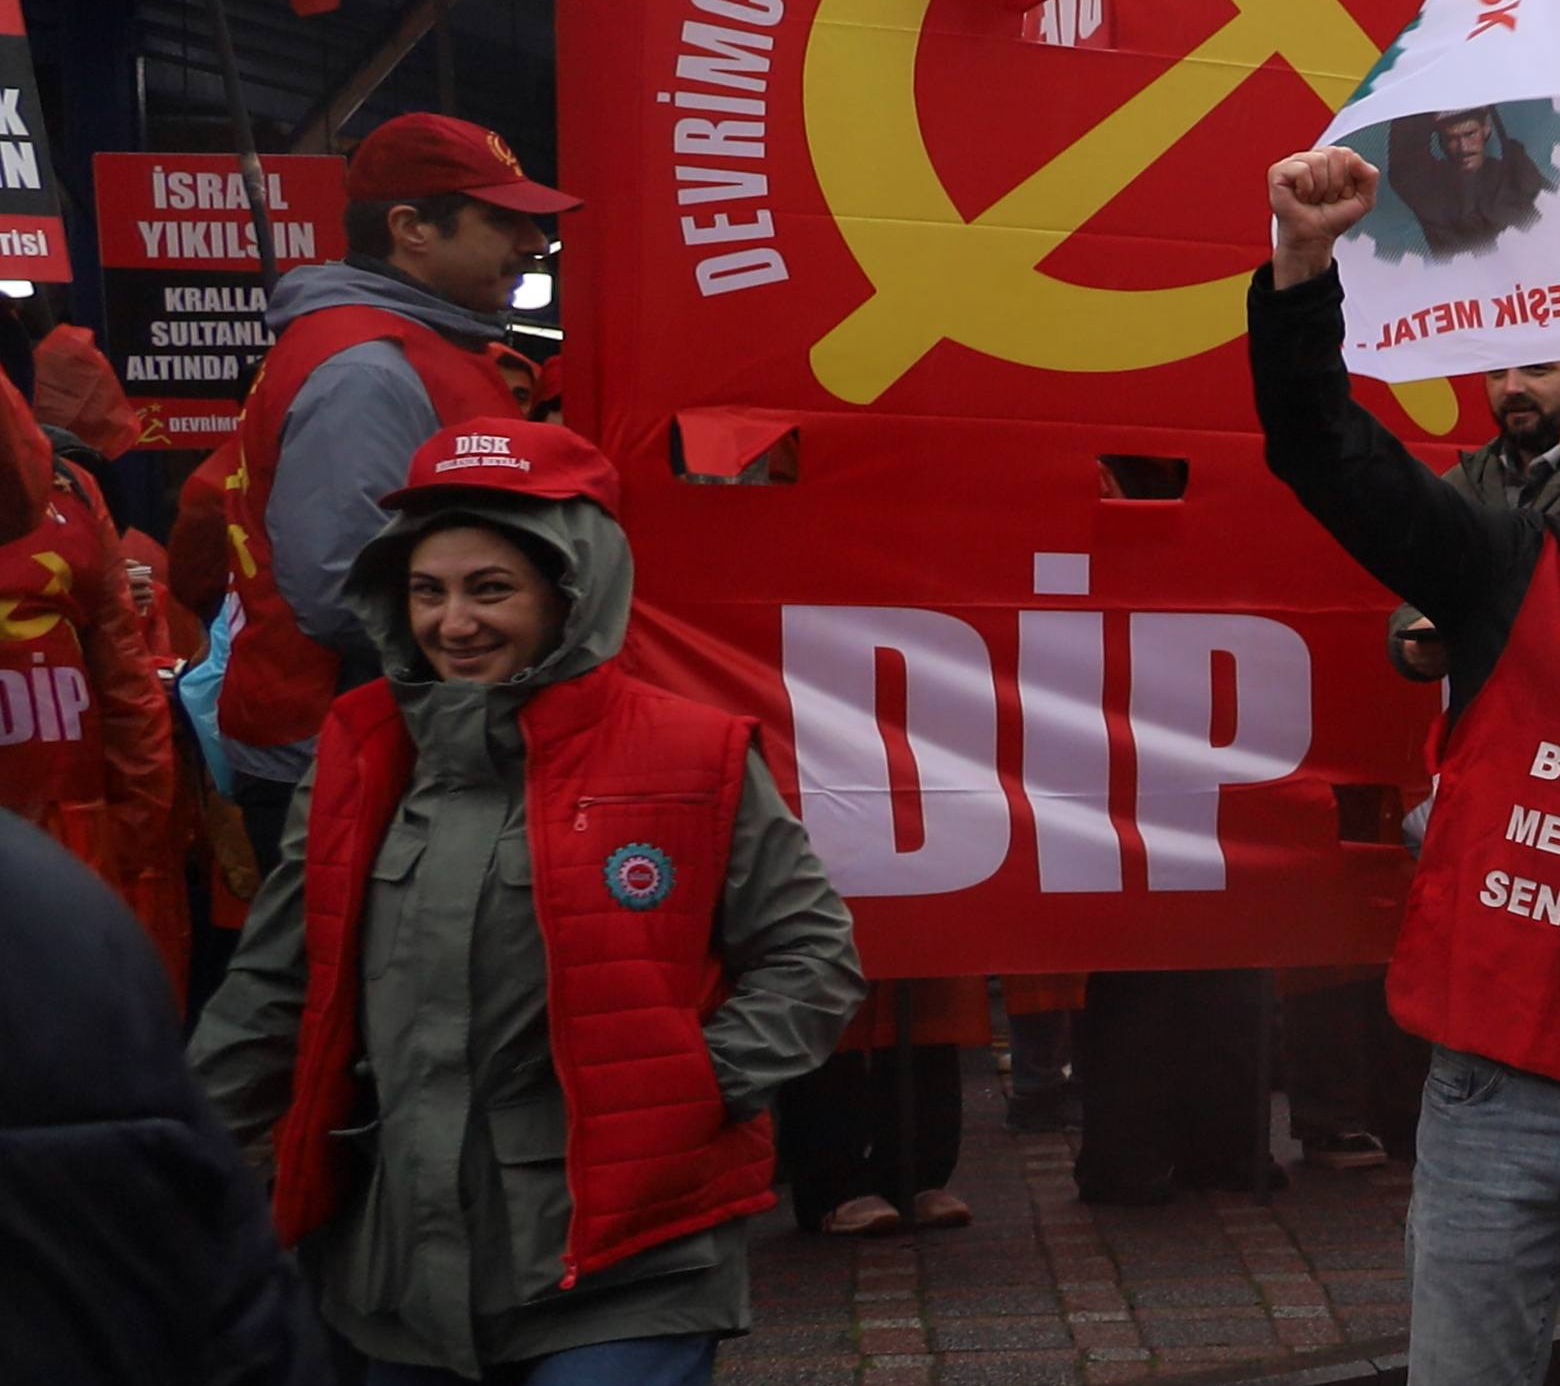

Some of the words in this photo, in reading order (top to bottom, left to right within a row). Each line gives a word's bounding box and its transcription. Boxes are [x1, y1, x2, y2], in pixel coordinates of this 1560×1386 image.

[152, 165, 288, 211] İSRAL
[0, 229, 49, 257] TİSİ
[163, 286, 268, 313] KRALLA
[126, 355, 239, 381] ALTINDA
[454, 433, 511, 455] DİSK
[0, 651, 91, 747] DİP
[781, 551, 1313, 898] DİP
